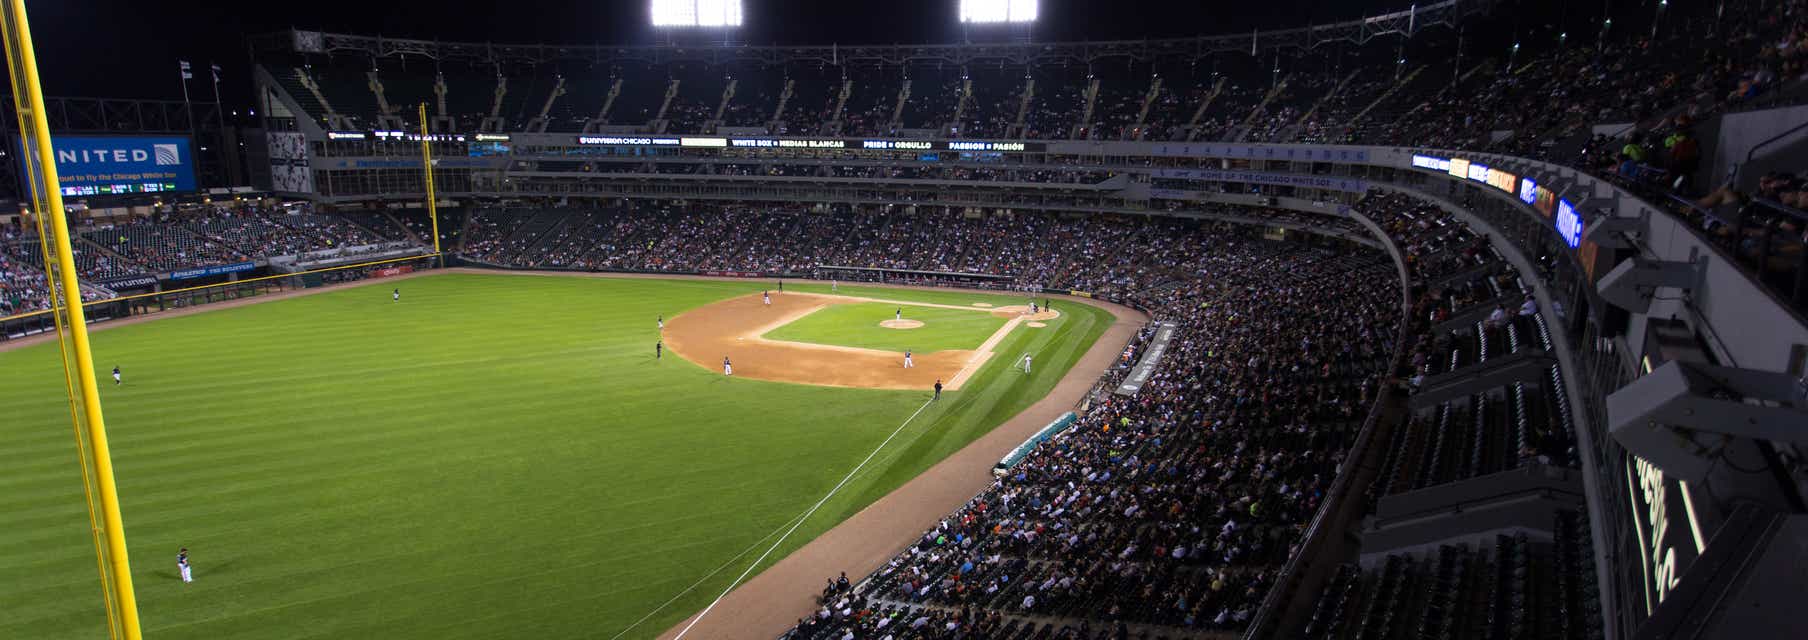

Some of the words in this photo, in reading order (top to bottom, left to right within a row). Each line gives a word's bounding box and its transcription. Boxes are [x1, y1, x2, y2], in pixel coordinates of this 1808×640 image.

[732, 139, 756, 147] WHITE
[809, 140, 844, 148] BLANCAS
[894, 141, 932, 149] ORGULLO
[949, 142, 985, 150] PASSION
[993, 142, 1025, 151] PASIÓN
[1255, 174, 1290, 183] CHICAGO
[1292, 177, 1314, 185] WHITE
[110, 277, 157, 288] HYUNDAI
